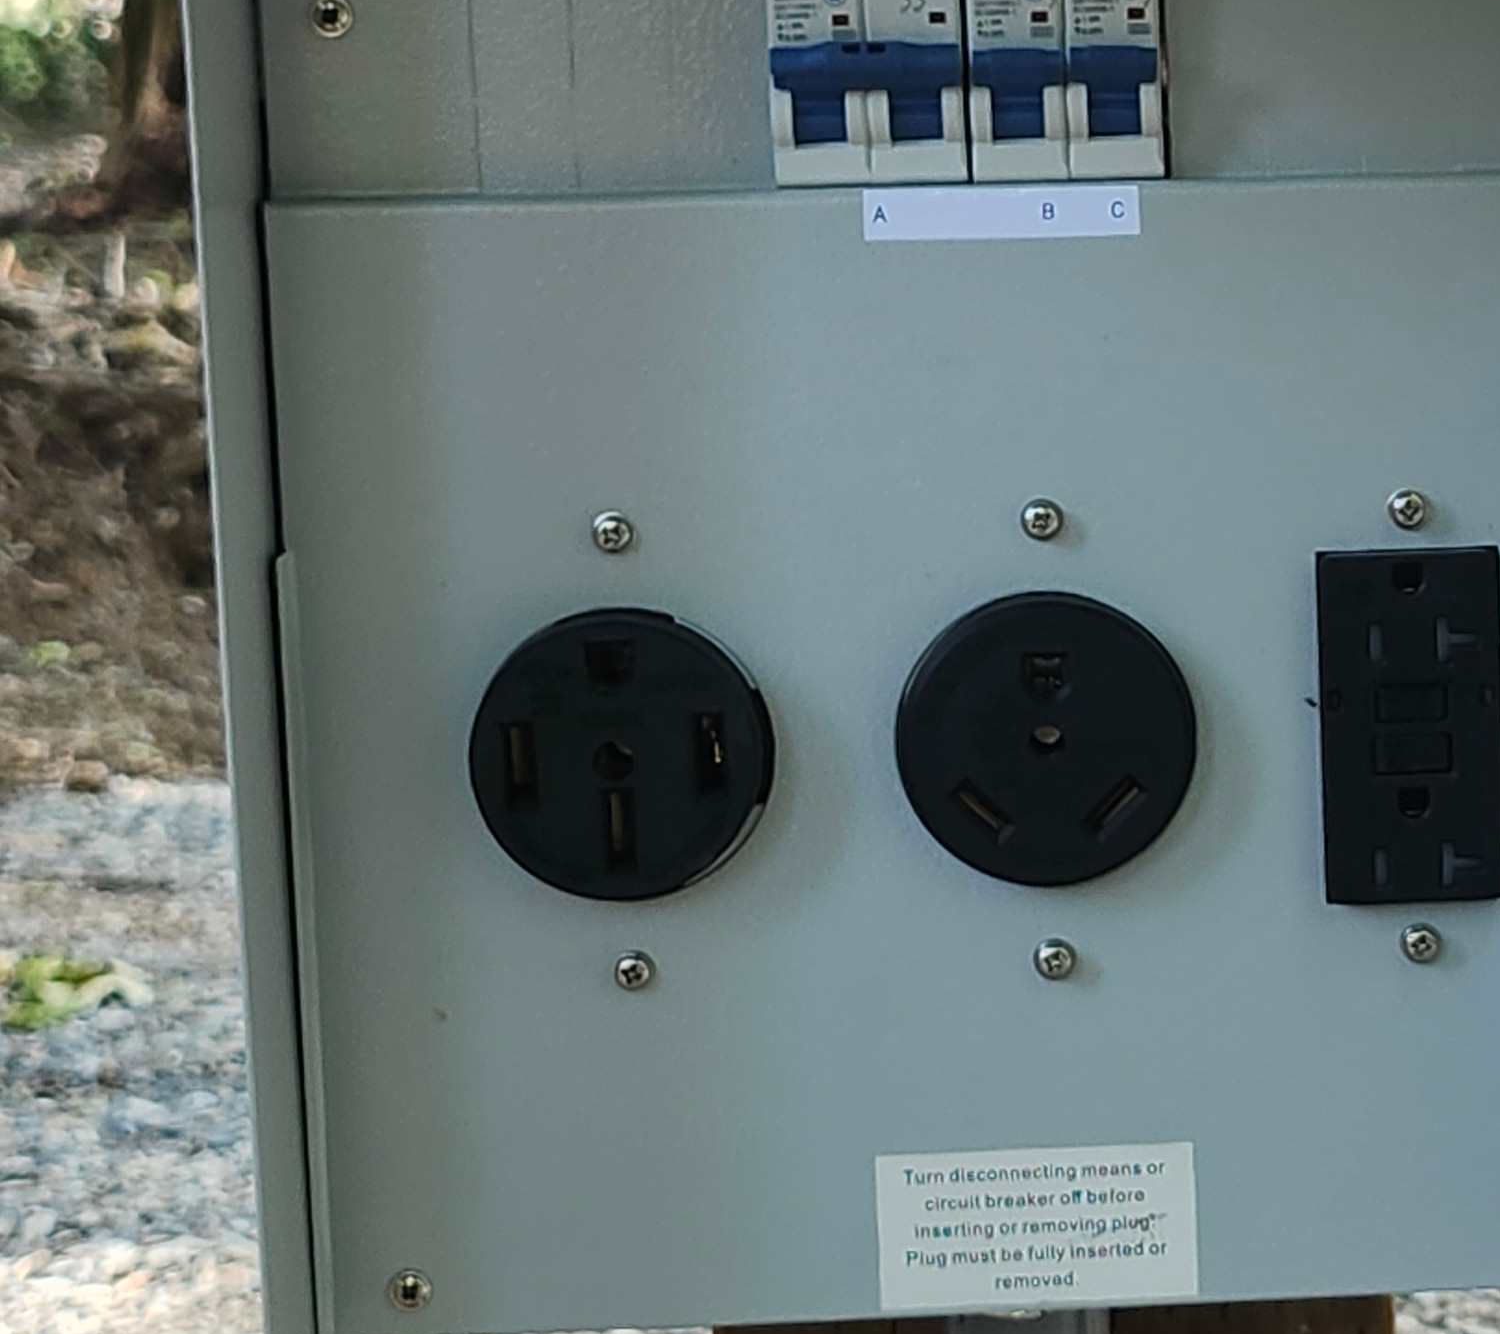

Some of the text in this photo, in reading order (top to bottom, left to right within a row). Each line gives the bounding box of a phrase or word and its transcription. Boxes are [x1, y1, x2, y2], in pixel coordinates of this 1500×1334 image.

[872, 201, 1126, 224] A B C
[904, 1162, 1164, 1185] Turn disconnecting means or
[925, 1188, 1145, 1211] circuit breaker off before
[914, 1221, 994, 1239] inserting
[999, 1222, 1017, 1236] or
[1022, 1216, 1106, 1234] removing
[905, 1242, 1166, 1269] Plug must be fully inserted or
